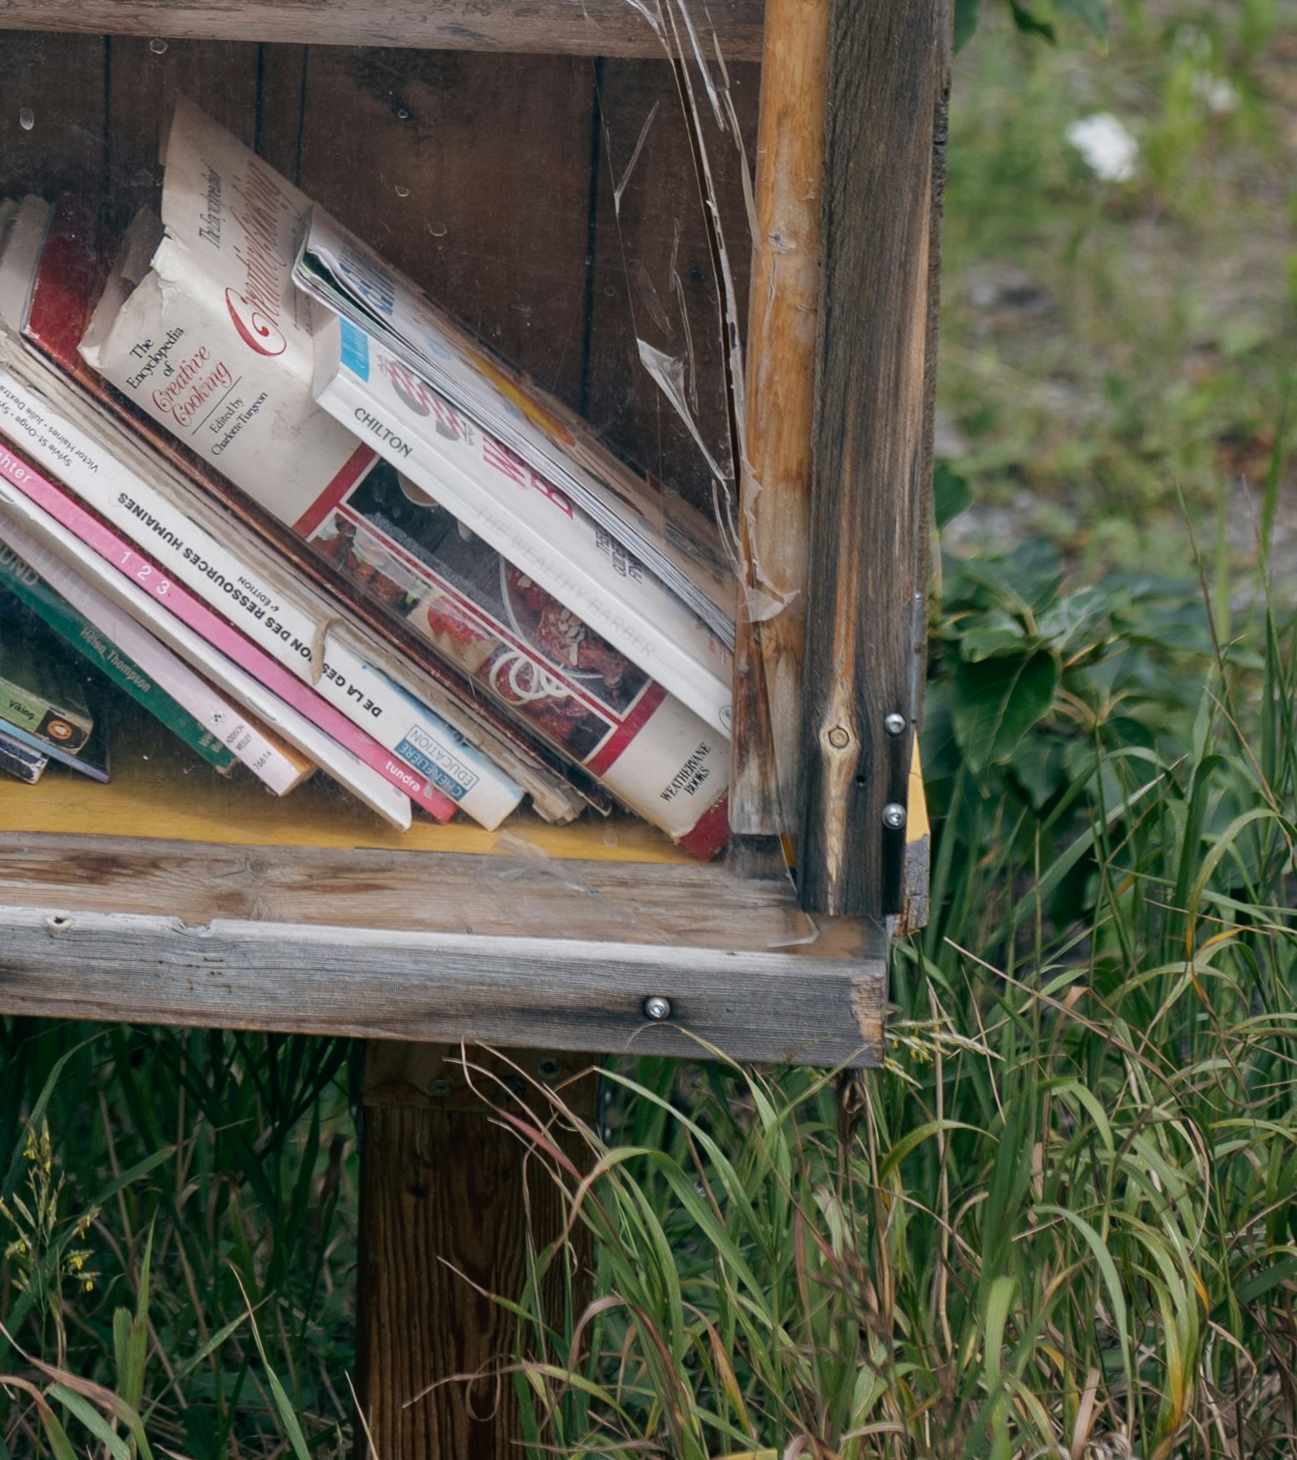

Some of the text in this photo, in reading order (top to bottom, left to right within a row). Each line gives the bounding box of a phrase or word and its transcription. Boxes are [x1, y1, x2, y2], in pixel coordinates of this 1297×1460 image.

[125, 324, 185, 391] Encyclopedia
[129, 336, 154, 361] The
[152, 344, 212, 414] Creative
[162, 361, 177, 379] of
[171, 359, 234, 428] Cooking
[353, 407, 414, 459] CHILTON
[7, 698, 36, 721] Viking
[384, 759, 422, 792] tundra
